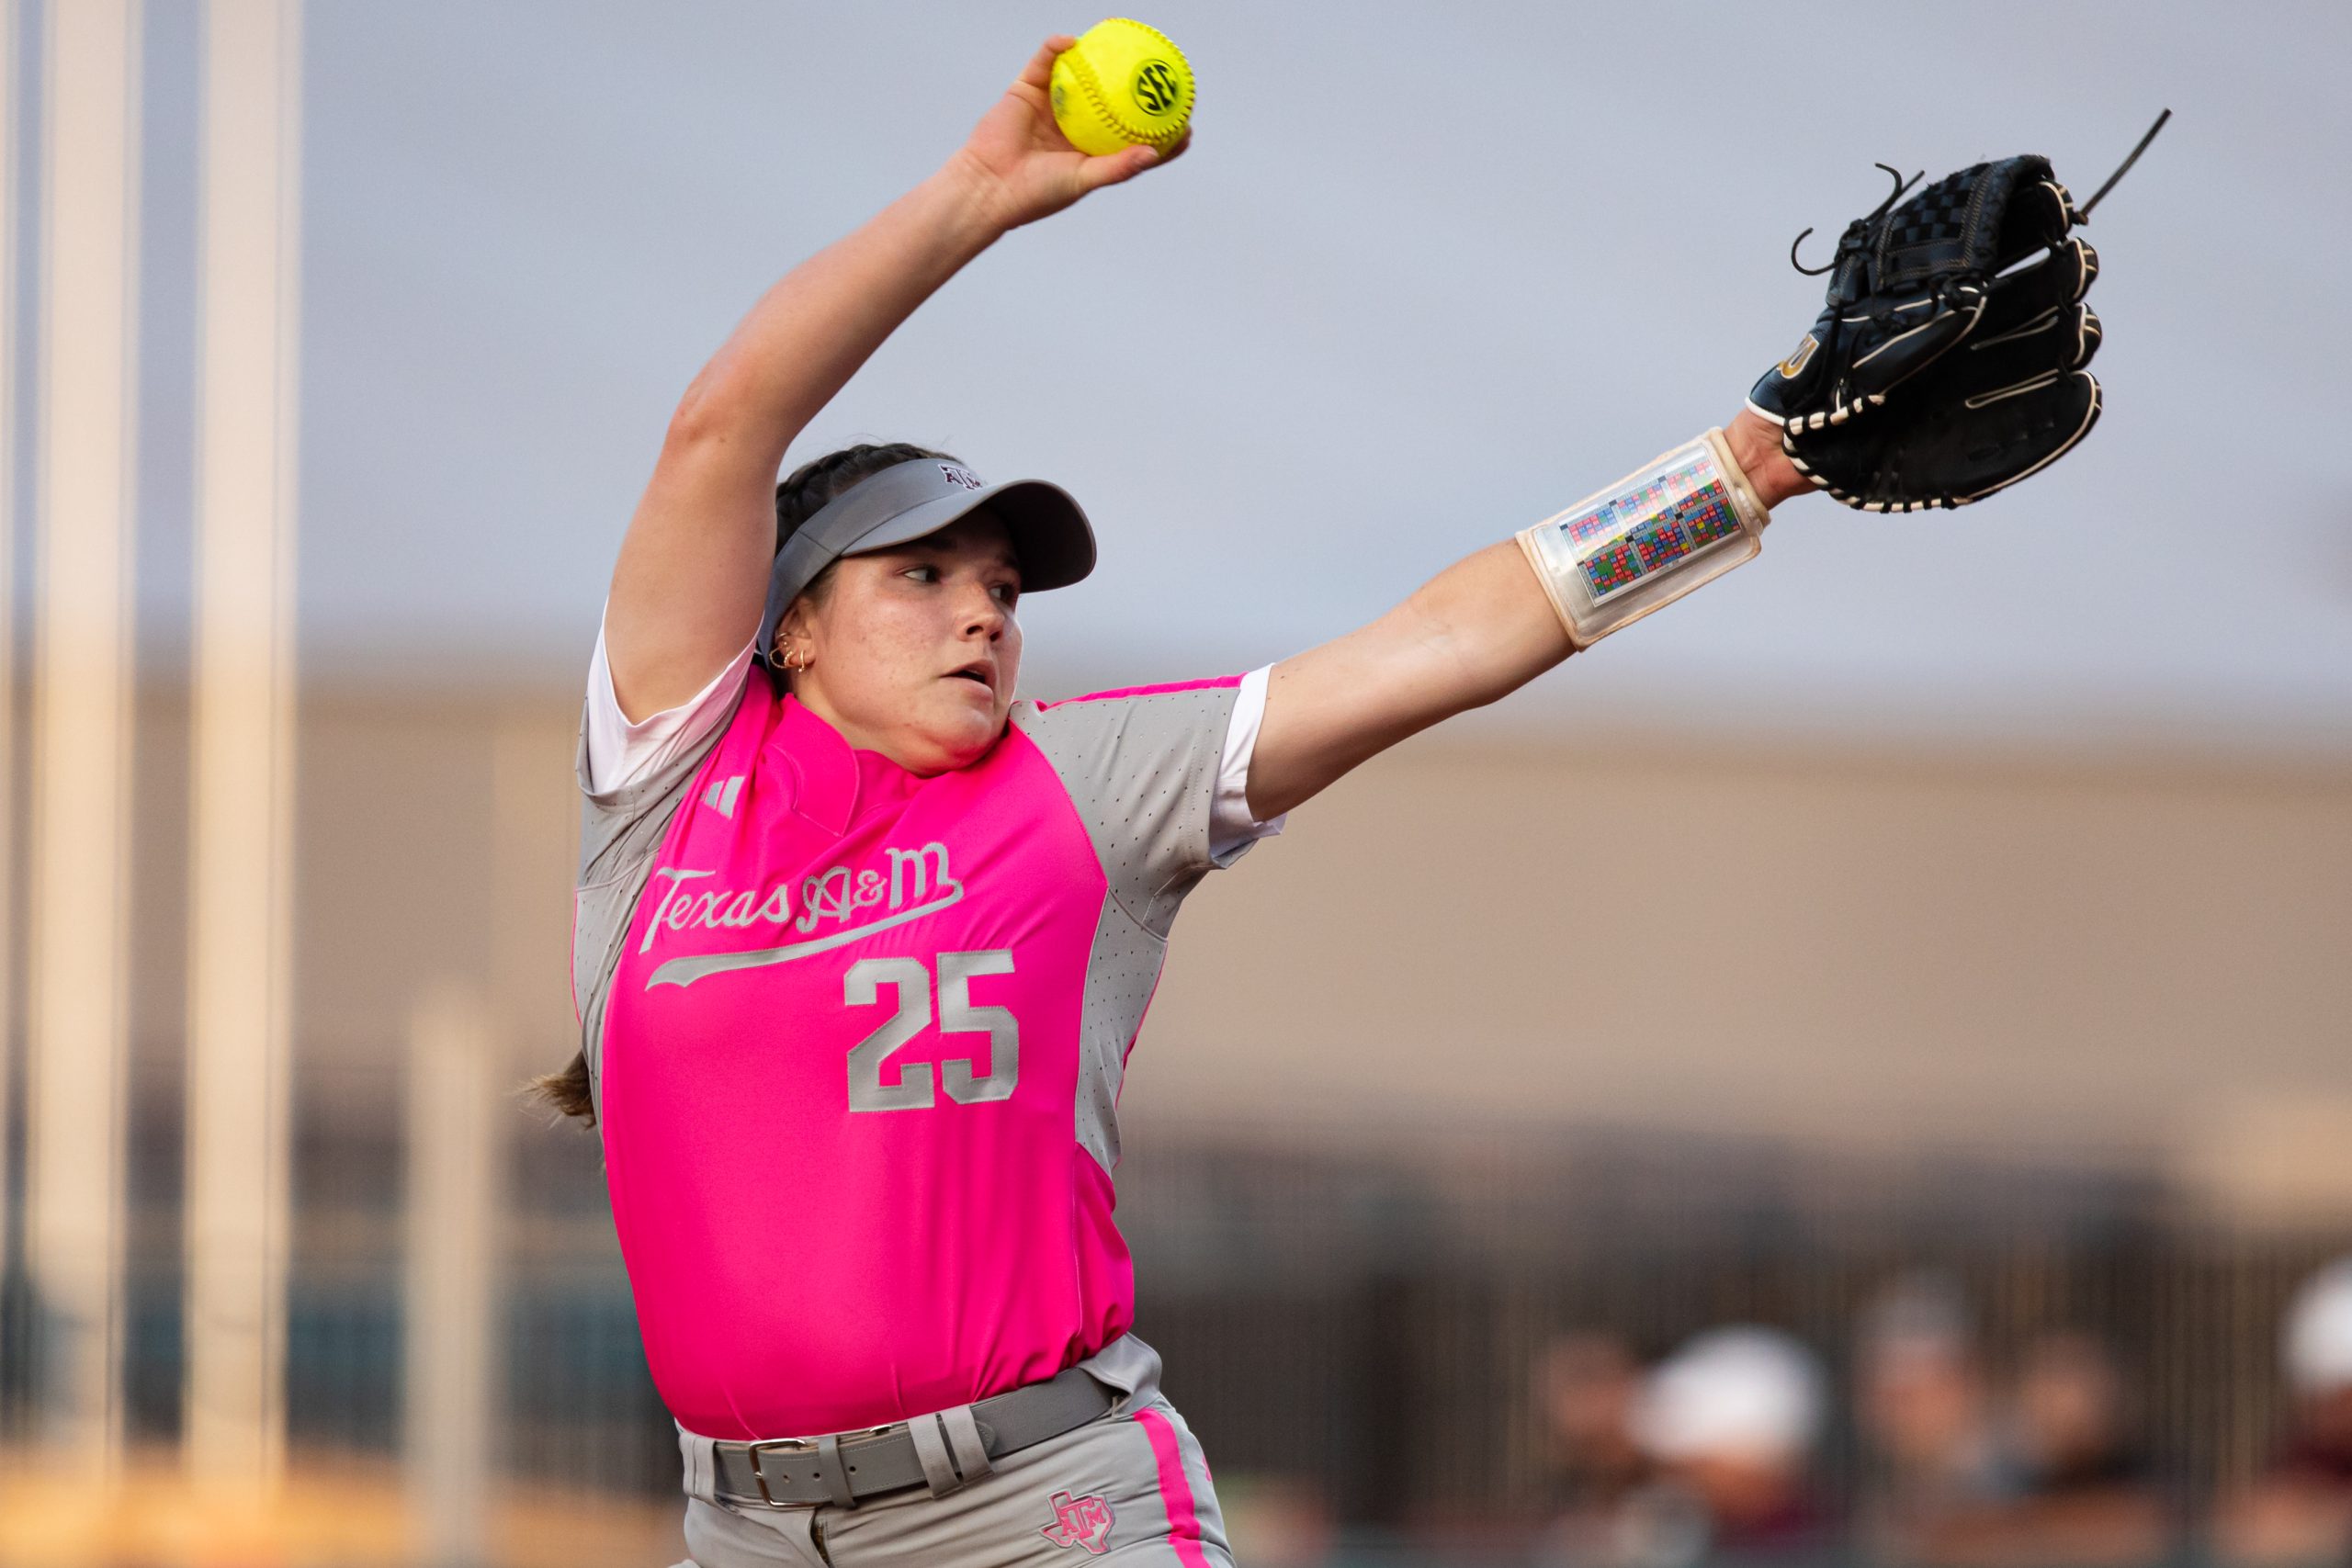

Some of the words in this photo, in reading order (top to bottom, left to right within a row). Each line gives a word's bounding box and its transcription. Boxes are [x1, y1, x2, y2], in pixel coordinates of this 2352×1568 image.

[638, 866, 791, 955] Texas
[795, 840, 961, 934] A&M
[843, 948, 1019, 1113] 25
